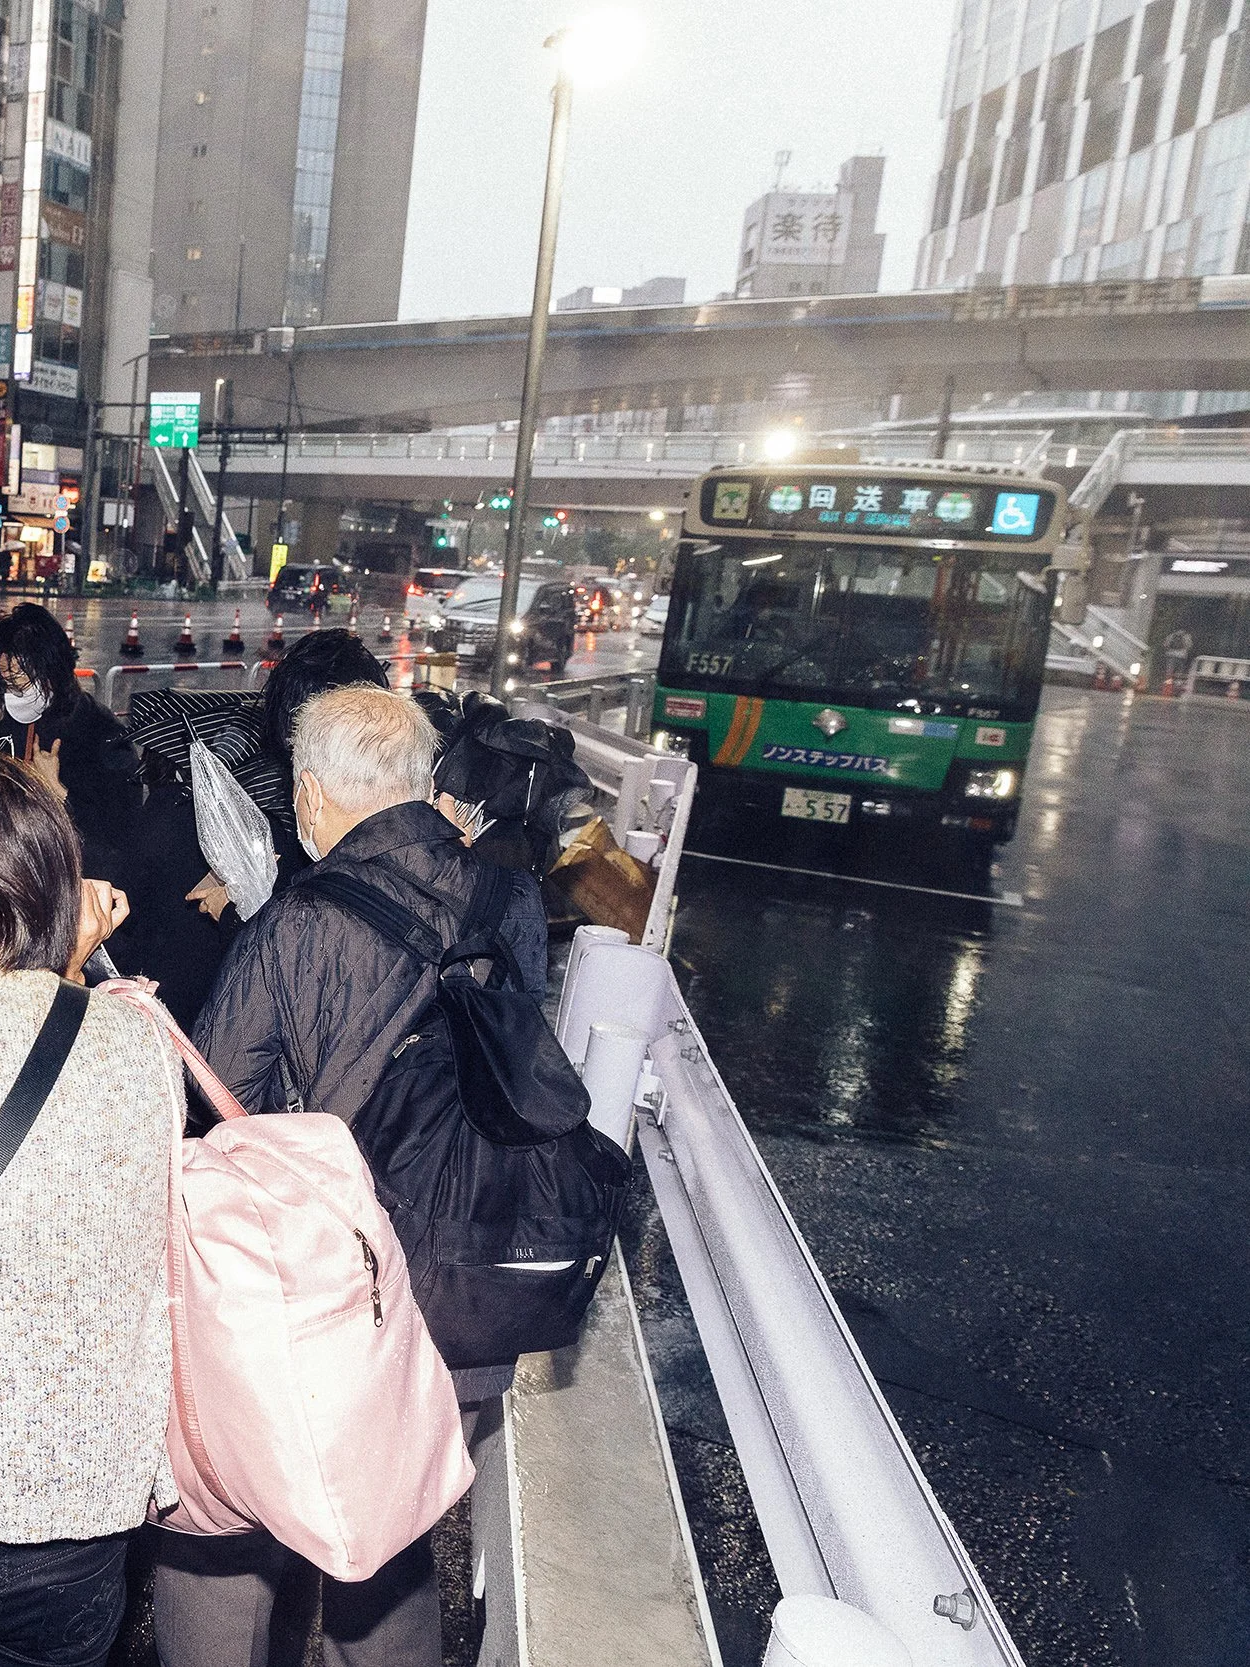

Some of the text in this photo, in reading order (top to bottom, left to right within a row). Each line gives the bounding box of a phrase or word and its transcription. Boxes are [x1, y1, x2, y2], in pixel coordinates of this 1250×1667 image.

[772, 212, 842, 243] 楽待
[686, 652, 735, 676] F557
[762, 745, 889, 773] ノンステップバス
